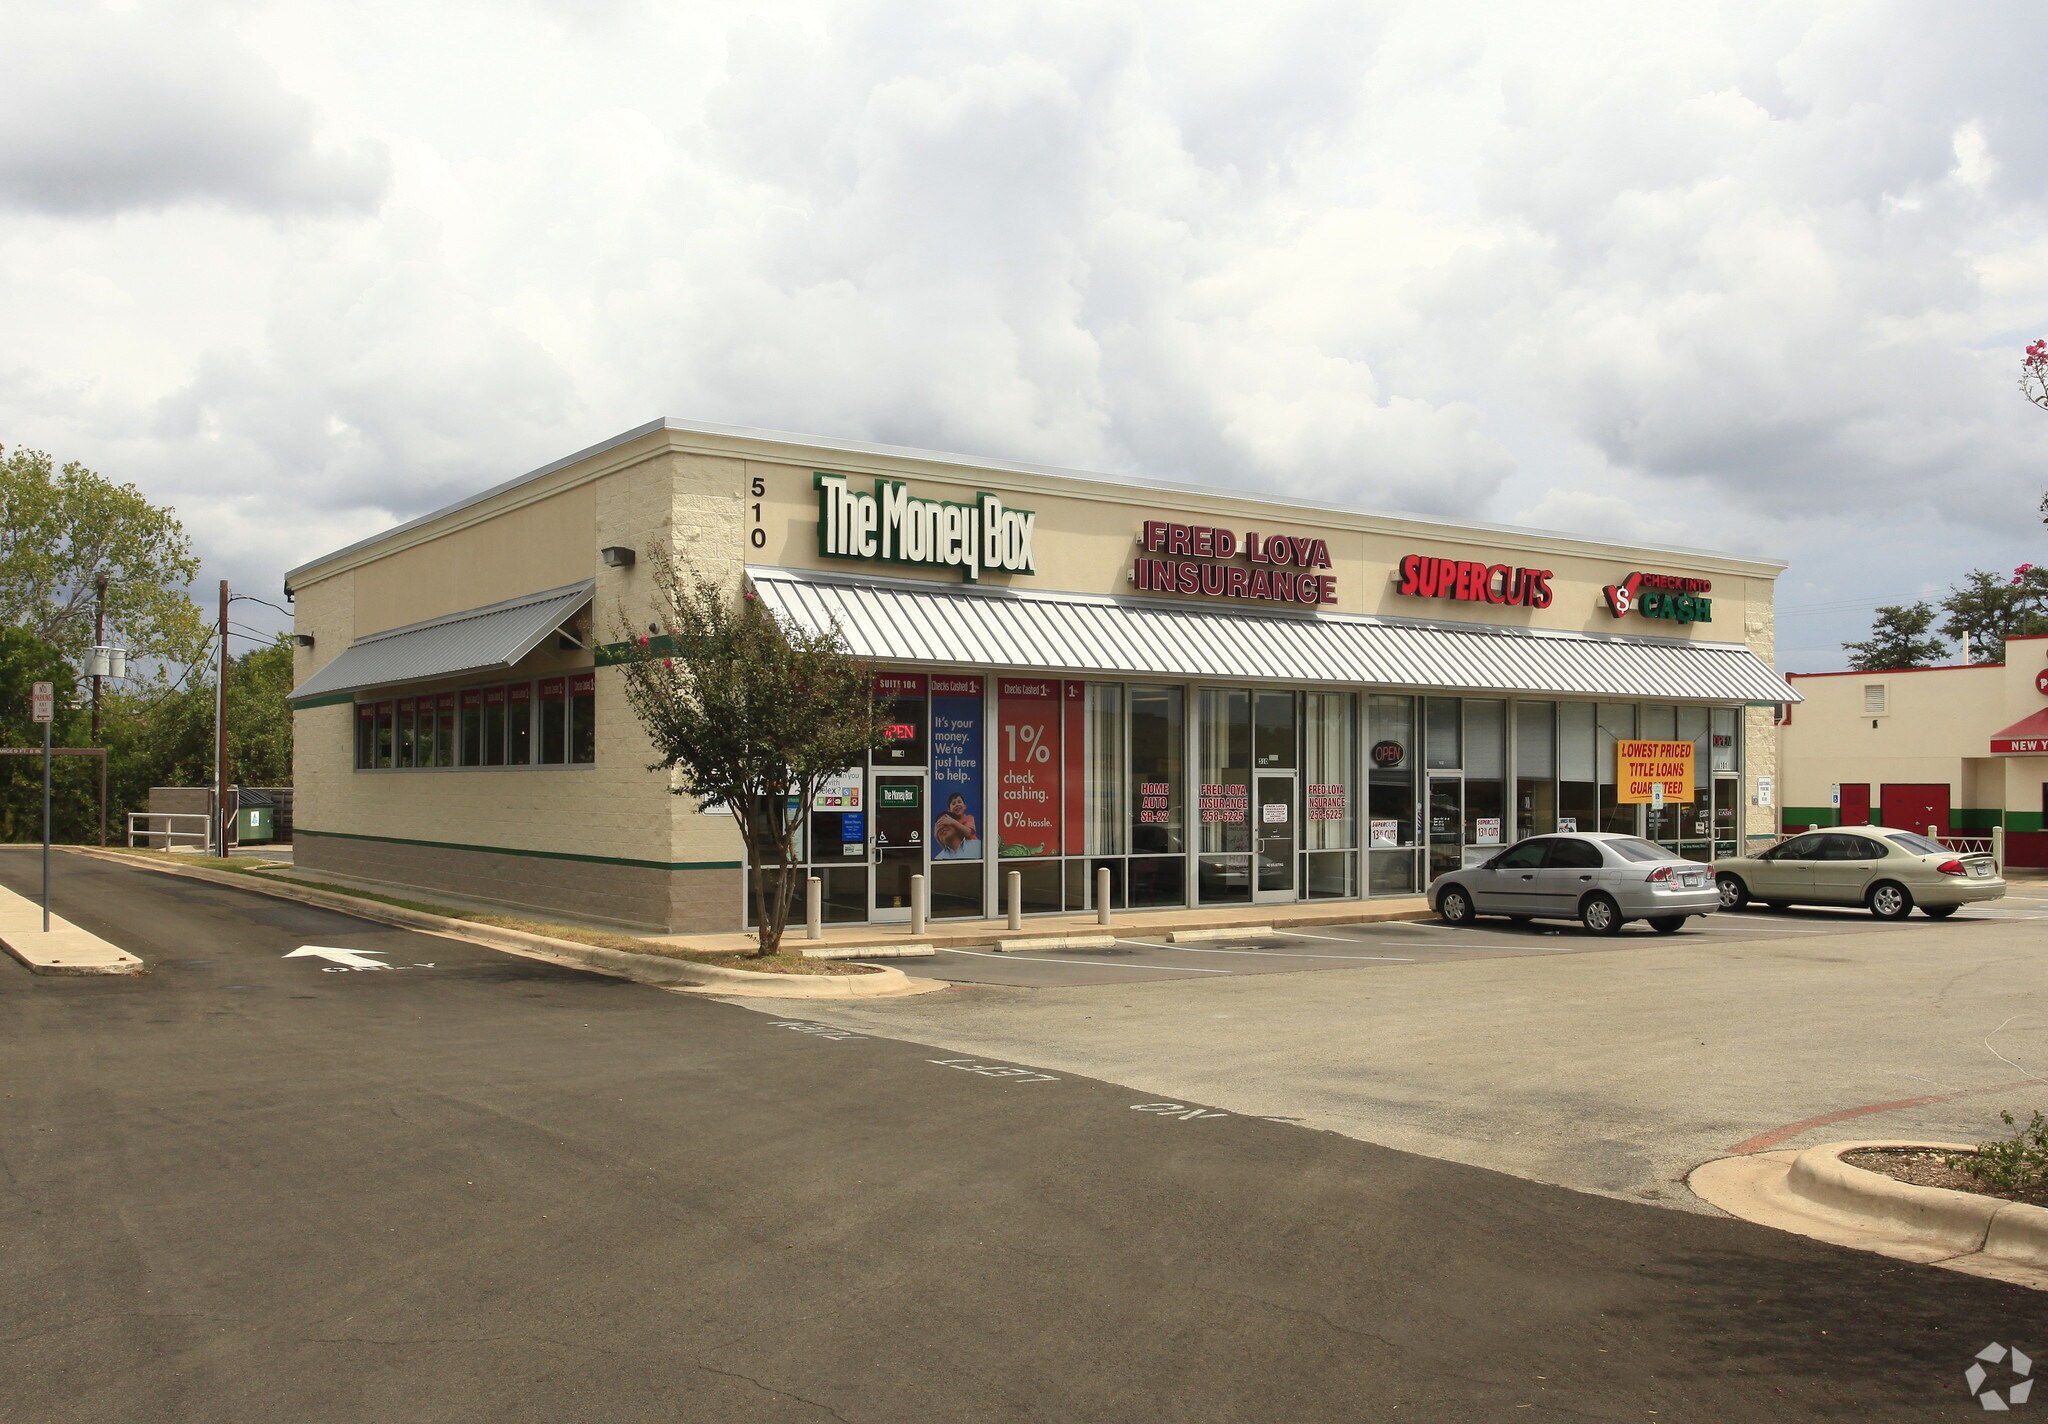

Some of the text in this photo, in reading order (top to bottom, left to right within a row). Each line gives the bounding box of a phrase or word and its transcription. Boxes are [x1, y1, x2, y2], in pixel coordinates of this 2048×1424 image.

[819, 474, 1036, 580] The Money Box
[1144, 520, 1333, 569] FRED LOYA
[1134, 558, 1338, 604] INSURANCE
[1398, 554, 1554, 609] SUPERCUTS
[1643, 573, 1712, 592] CHECK INTO
[903, 681, 916, 689] 104
[931, 681, 950, 692] Checks
[950, 681, 969, 692] Cashed
[1004, 684, 1022, 695] Checks
[1022, 684, 1040, 696] Cashed
[935, 716, 974, 731] It's your
[935, 732, 970, 745] money.
[1005, 725, 1050, 764] 1%
[935, 743, 964, 754] We're
[1622, 744, 1691, 758] LOWEST PRICED
[2011, 741, 2037, 751] NEW
[1375, 746, 1400, 761] OPEN
[935, 755, 976, 770] just here
[1629, 762, 1684, 777] TITLE LOANS
[935, 768, 971, 784] to help.
[1004, 769, 1035, 784] check
[1004, 786, 1049, 803] cashing.
[1141, 783, 1169, 795] HOME
[1200, 784, 1248, 796] FRED LOYA
[1308, 784, 1345, 795] FRED LOYA
[1630, 781, 1683, 795] GUARTEED
[1142, 797, 1168, 809] AUTO
[1199, 798, 1248, 809] INSURANCE
[1004, 811, 1053, 828] 0% hassle.
[1141, 810, 1169, 823] SR-22
[1202, 811, 1245, 823] 258-6225
[1310, 809, 1343, 821] 258-6225
[924, 1058, 1061, 1083] LEFT
